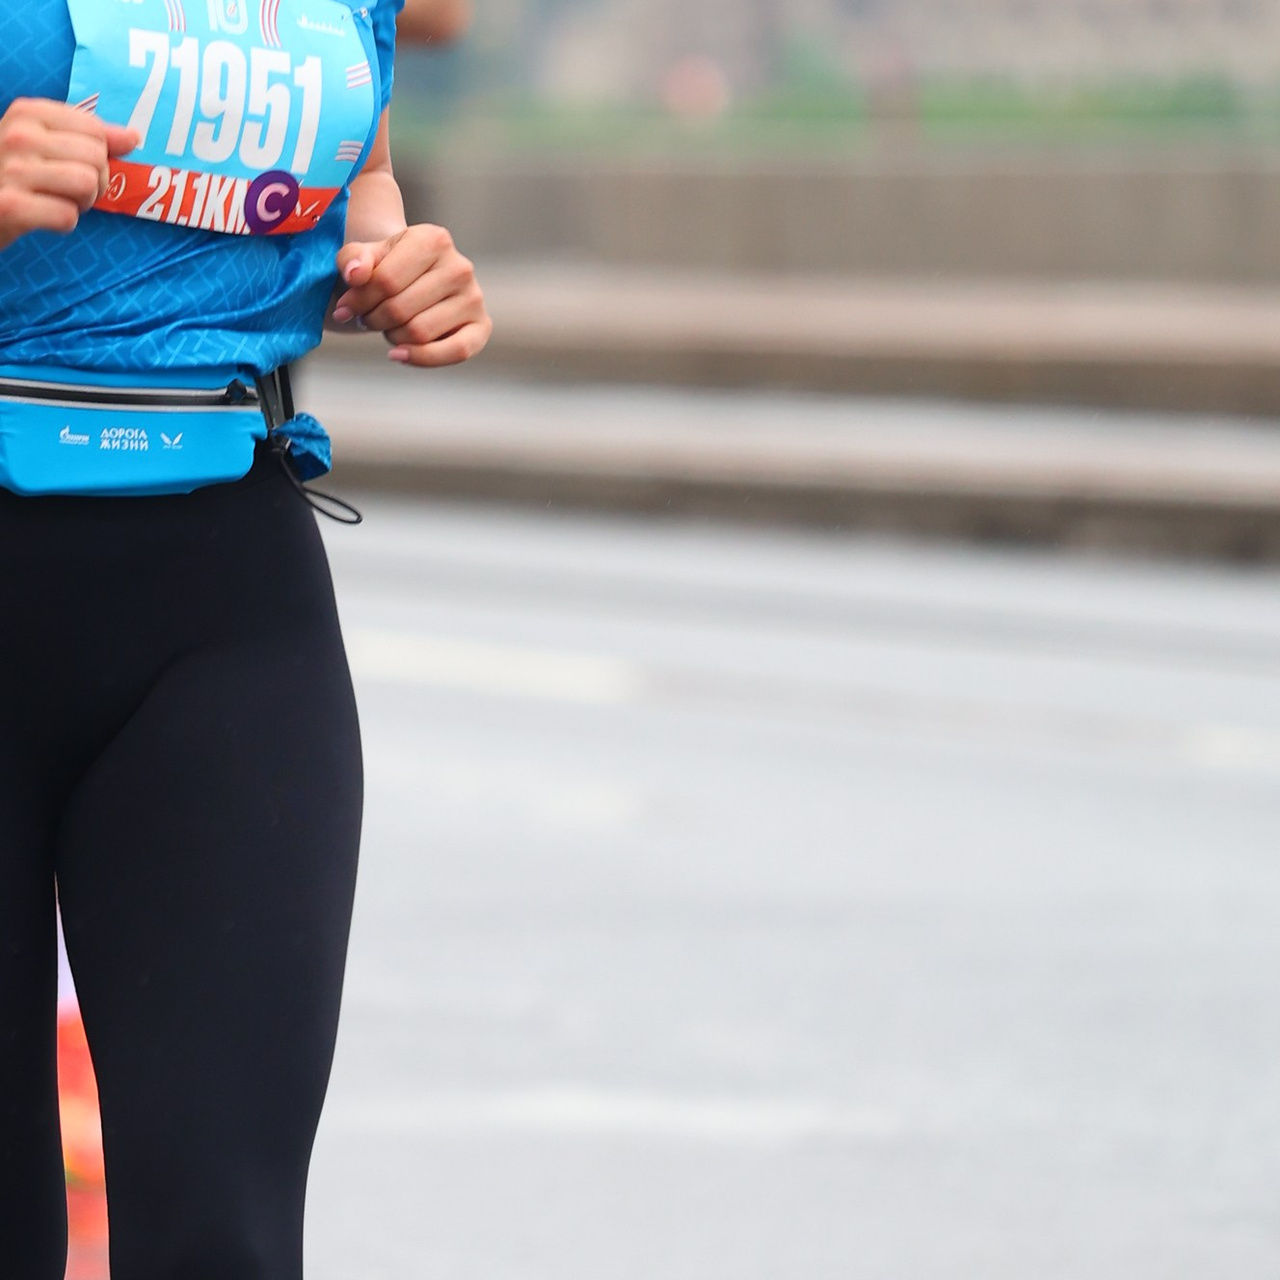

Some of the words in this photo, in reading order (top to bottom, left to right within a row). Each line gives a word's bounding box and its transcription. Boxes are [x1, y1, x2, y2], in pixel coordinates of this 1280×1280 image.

[126, 28, 322, 175] 71951
[100, 427, 148, 440] ДОРОГА
[100, 439, 148, 451] ЖИЗНИ
